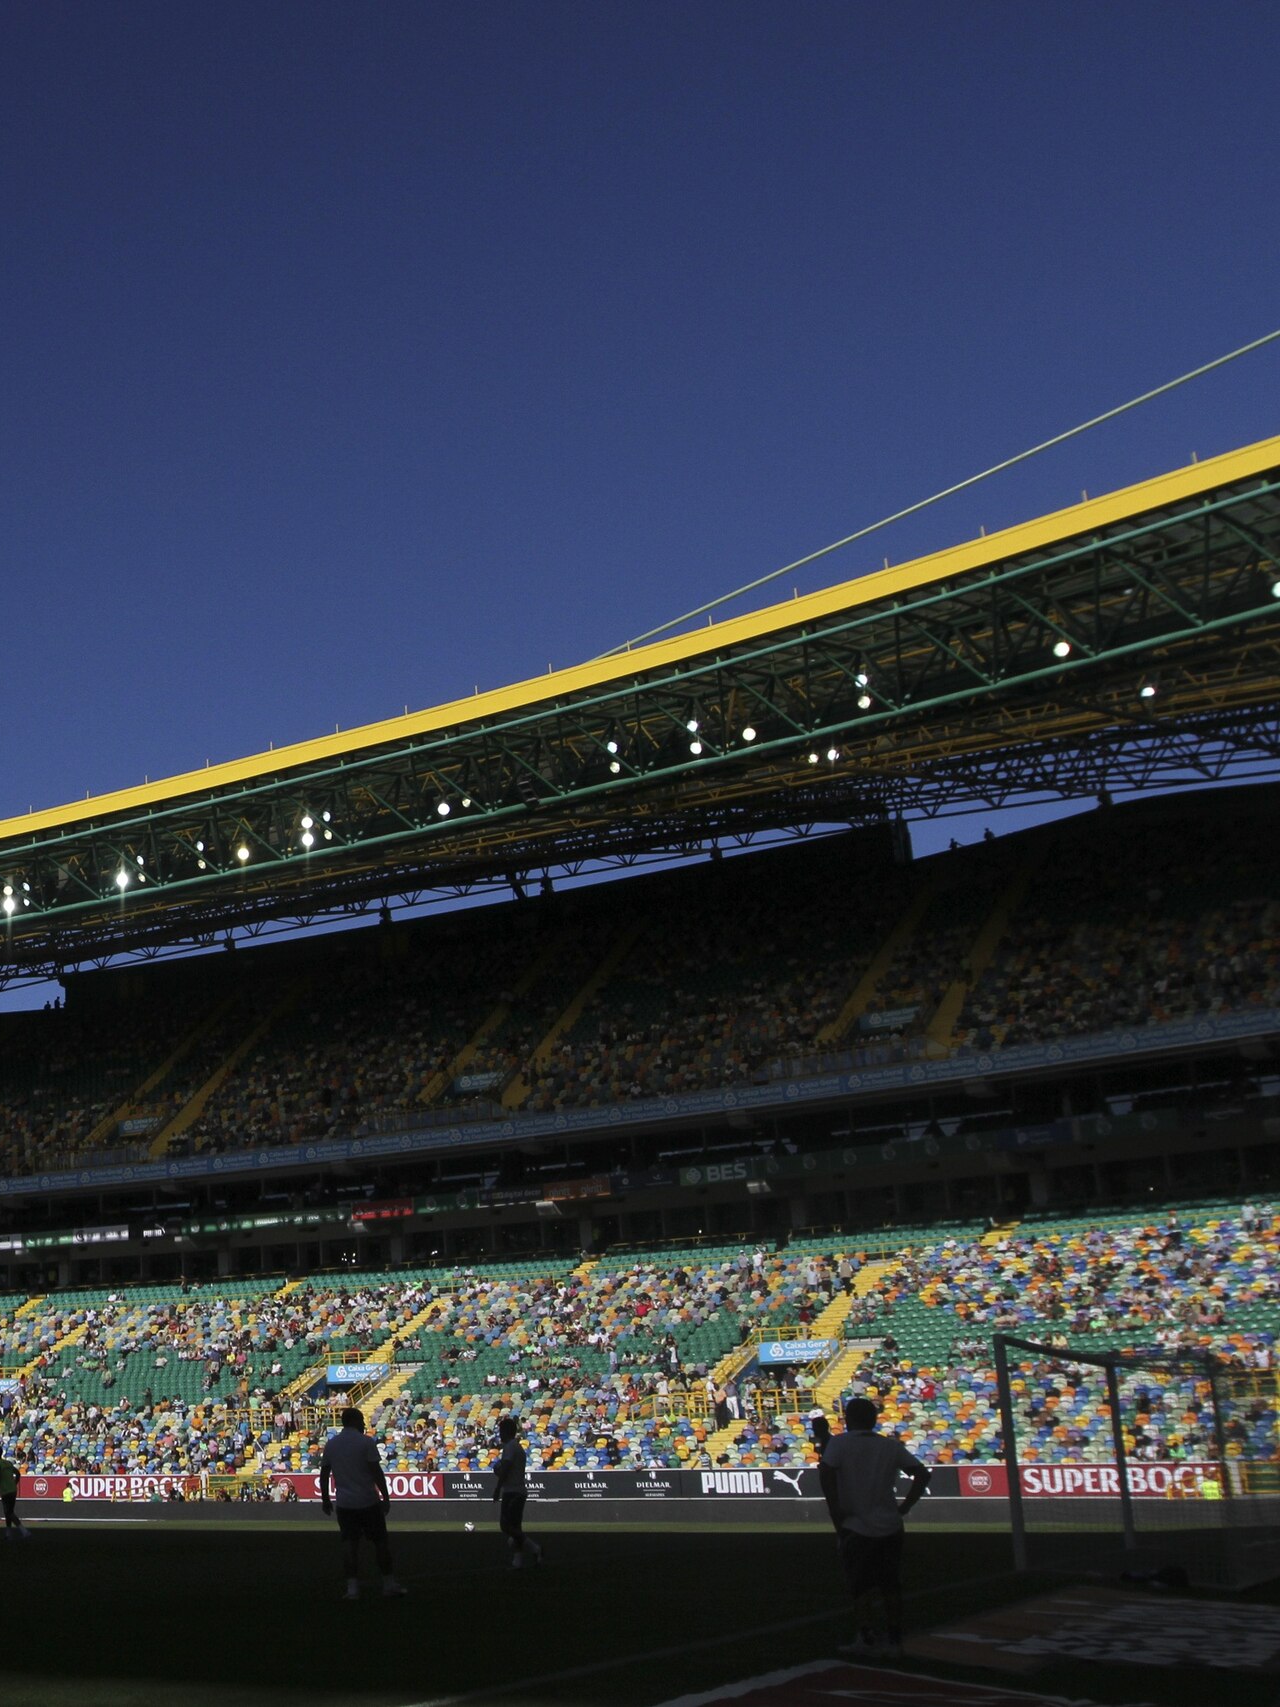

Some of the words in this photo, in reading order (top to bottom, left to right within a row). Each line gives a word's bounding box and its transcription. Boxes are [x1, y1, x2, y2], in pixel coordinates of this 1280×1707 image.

[706, 1163, 747, 1182] BES
[348, 1364, 365, 1372] Caixa
[69, 1477, 128, 1498] SUPER
[384, 1476, 438, 1496] BOCK
[701, 1472, 765, 1494] PUMA
[1023, 1468, 1121, 1494] SUPER
